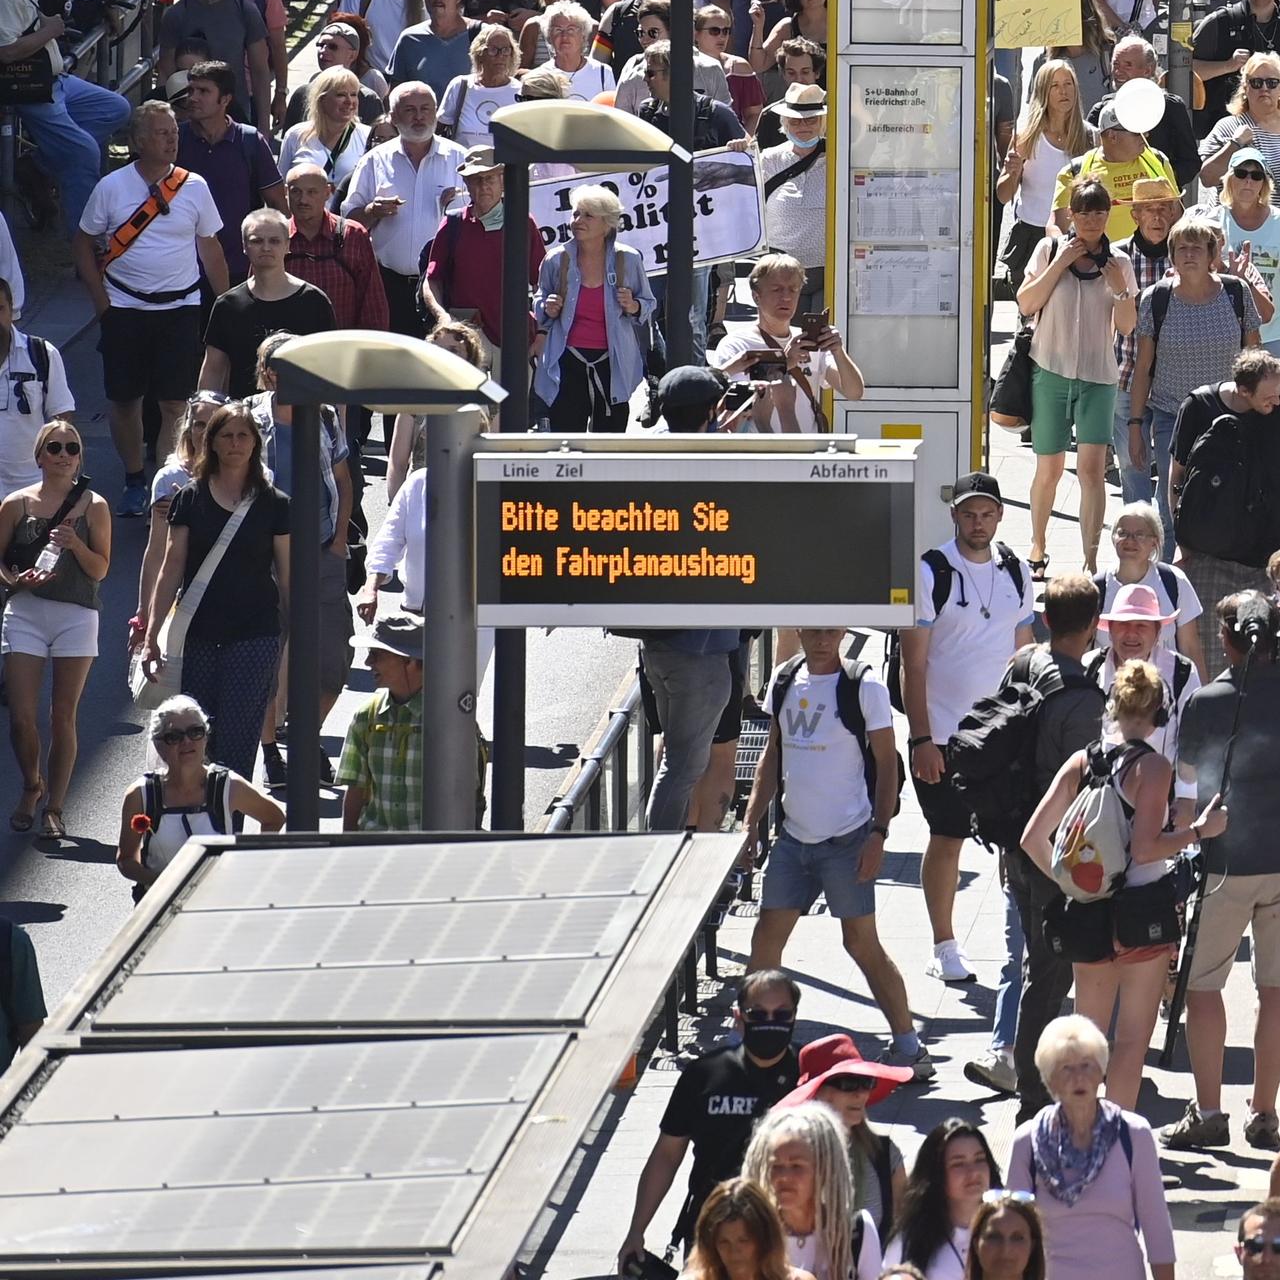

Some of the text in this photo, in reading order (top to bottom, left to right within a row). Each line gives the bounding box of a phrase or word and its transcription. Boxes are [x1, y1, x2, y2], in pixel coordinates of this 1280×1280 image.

[6, 62, 33, 73] nicht
[864, 87, 919, 99] S+U-Bahnhof
[864, 97, 926, 108] Friedrichstraße
[867, 123, 915, 134] Tarifbereich
[627, 171, 657, 199] %
[502, 463, 888, 480] Linie Ziel Abfahrt in
[501, 500, 729, 532] Bitte beachten Sie
[501, 547, 756, 585] den Fahrplanaushang
